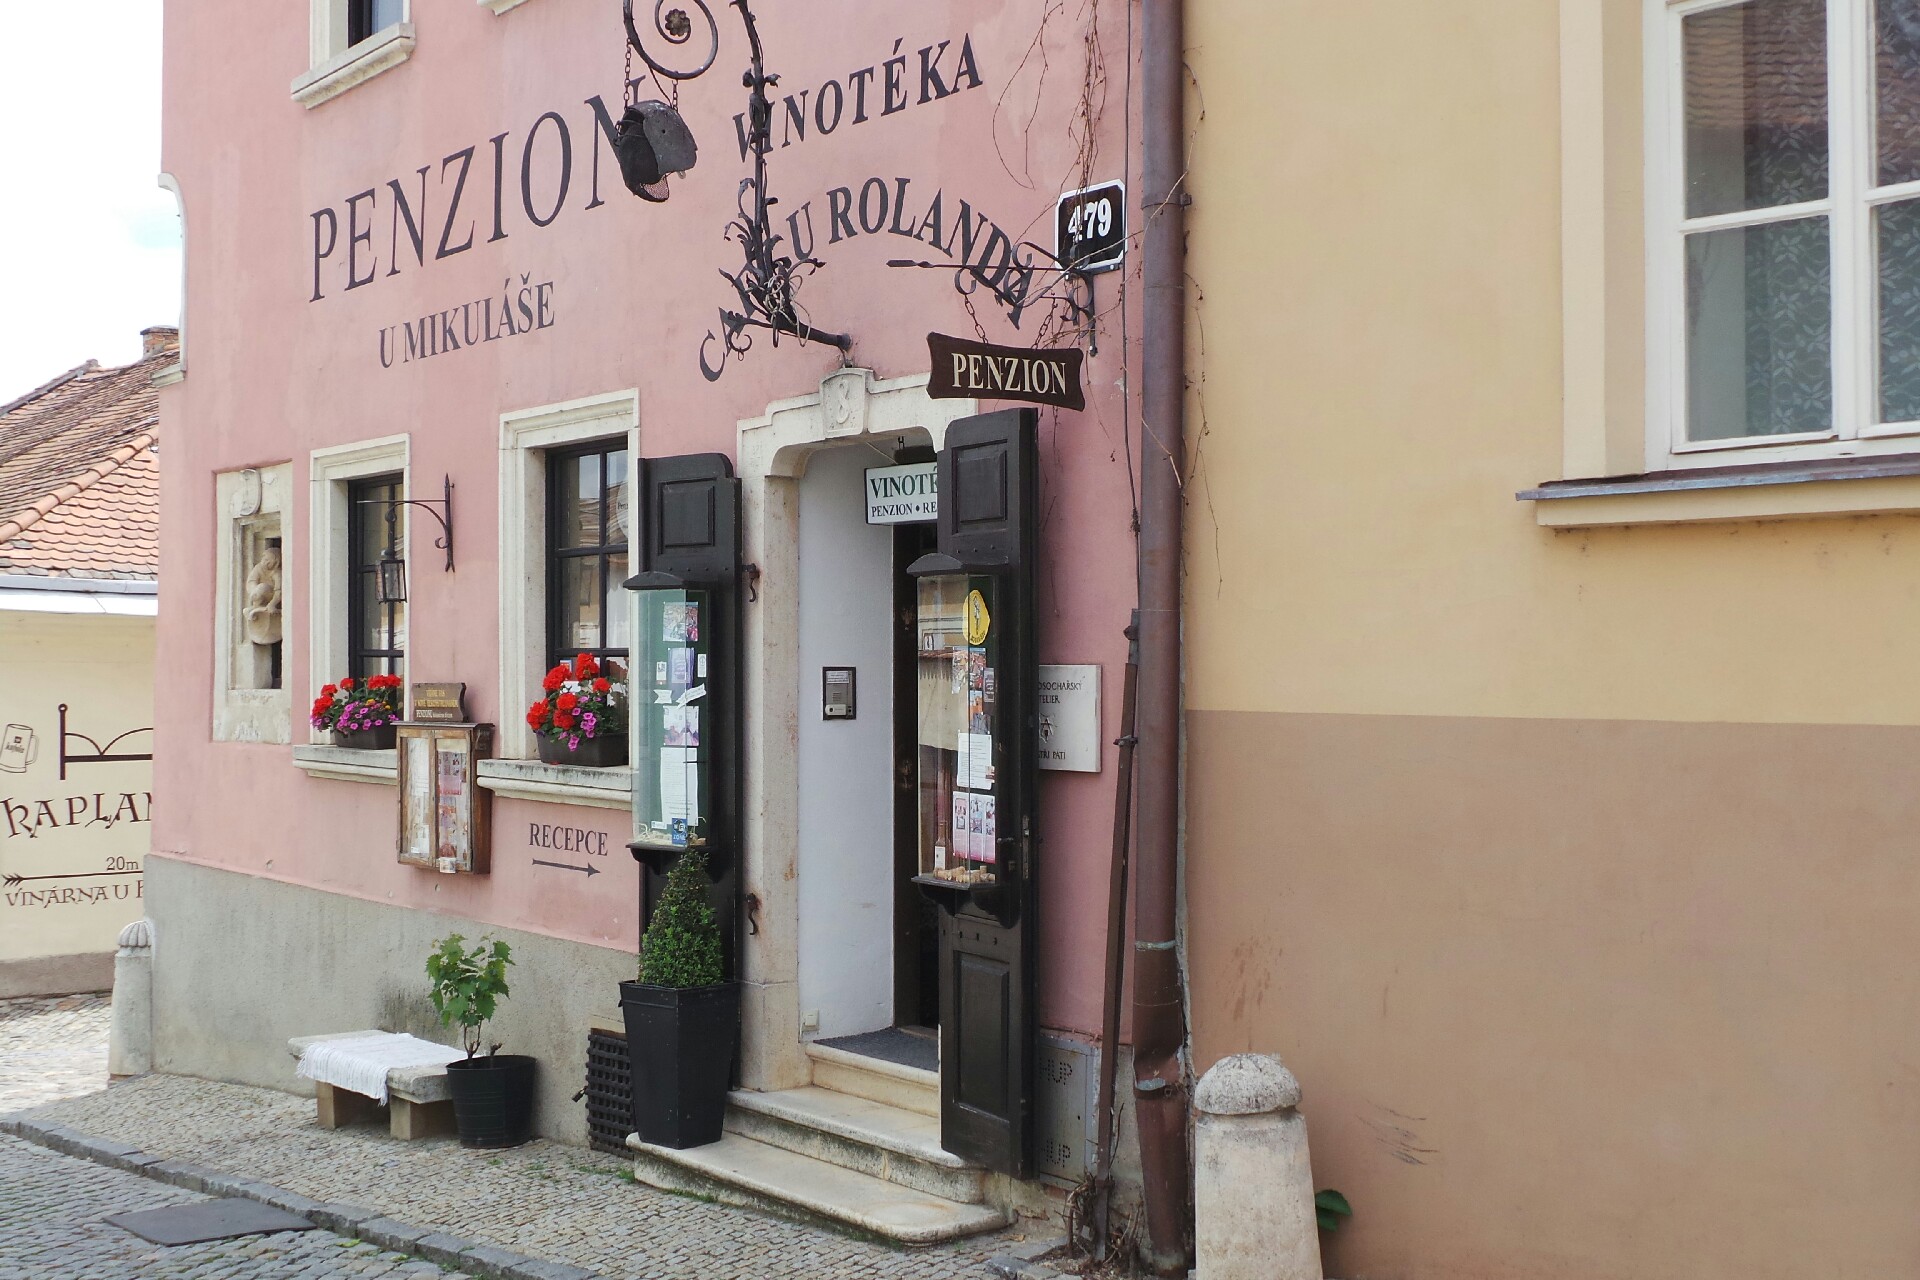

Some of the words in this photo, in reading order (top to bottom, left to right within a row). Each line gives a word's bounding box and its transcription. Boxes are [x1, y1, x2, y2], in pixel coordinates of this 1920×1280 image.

[308, 75, 647, 304] PENZION
[1067, 197, 1112, 242] 479
[378, 326, 396, 369] U
[402, 271, 555, 363] MIKULÁŠE
[951, 352, 1068, 396] PENZION
[871, 502, 913, 518] PENZION
[529, 822, 609, 857] RECEPCE
[105, 855, 139, 872] 20m
[5, 884, 109, 909] VINÁRNA
[113, 883, 130, 900] U
